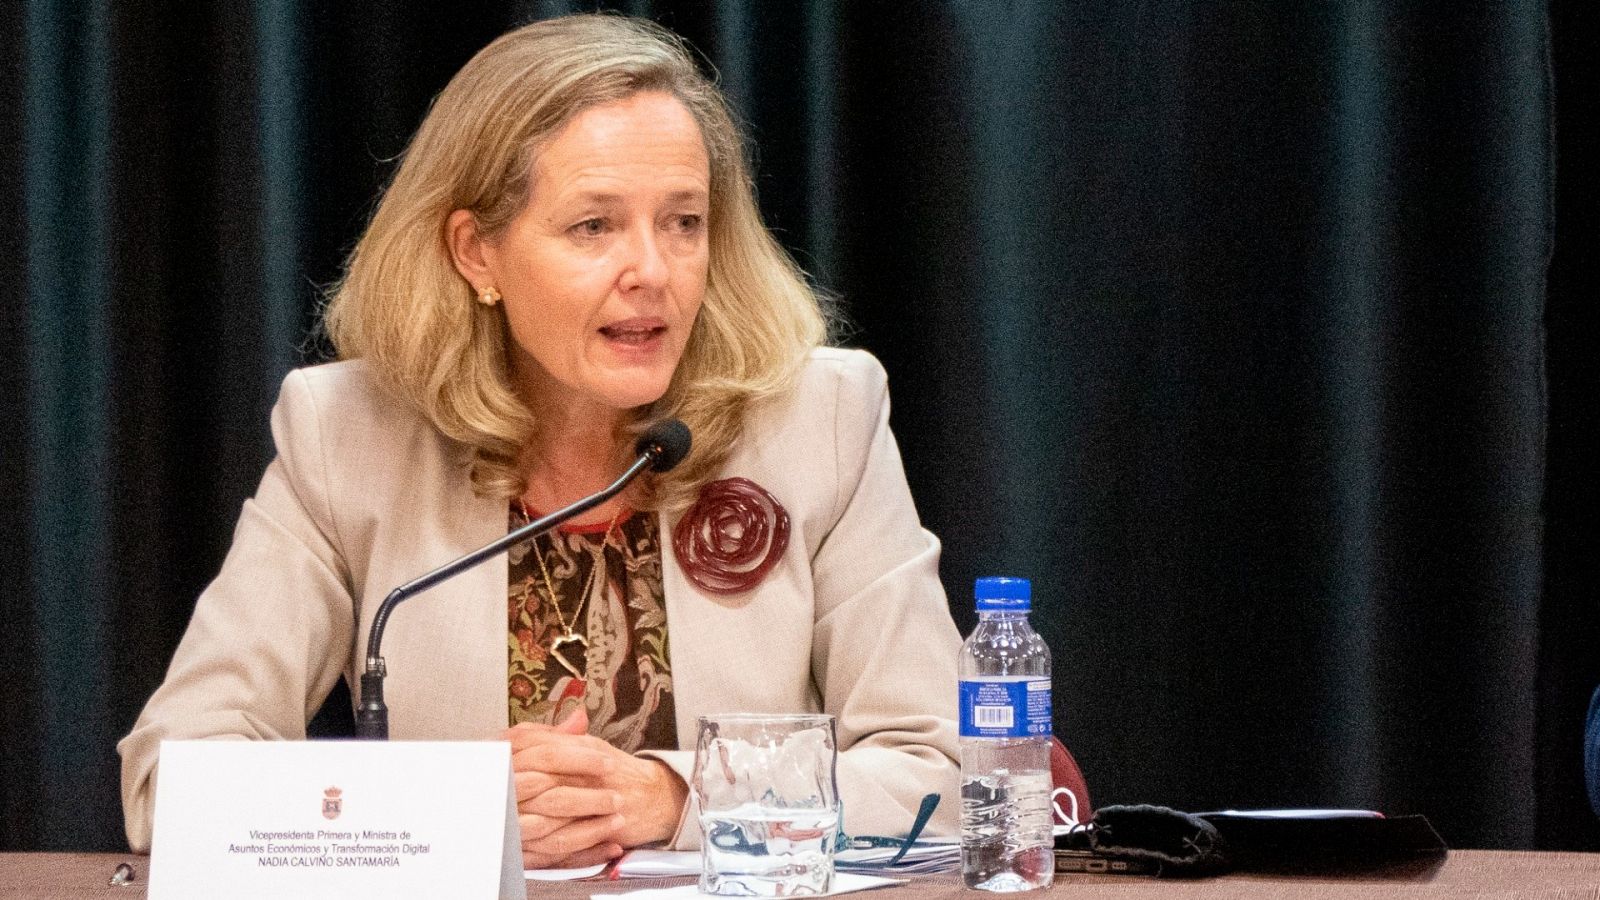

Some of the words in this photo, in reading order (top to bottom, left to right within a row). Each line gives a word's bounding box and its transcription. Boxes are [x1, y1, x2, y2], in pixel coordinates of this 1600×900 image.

[249, 830, 315, 841] Vicepresidenta
[317, 830, 352, 840] Primera
[354, 832, 360, 842] y
[362, 830, 397, 840] Ministra
[399, 830, 411, 840] de
[228, 844, 265, 854] Asuntos
[267, 844, 321, 854] Económicos
[323, 846, 329, 857] y
[331, 843, 400, 854] Transformación
[402, 843, 430, 856] Digital
[258, 857, 289, 867] NADIA
[290, 856, 334, 867] CALVIÑO
[336, 856, 400, 867] SANTAMARÍA
